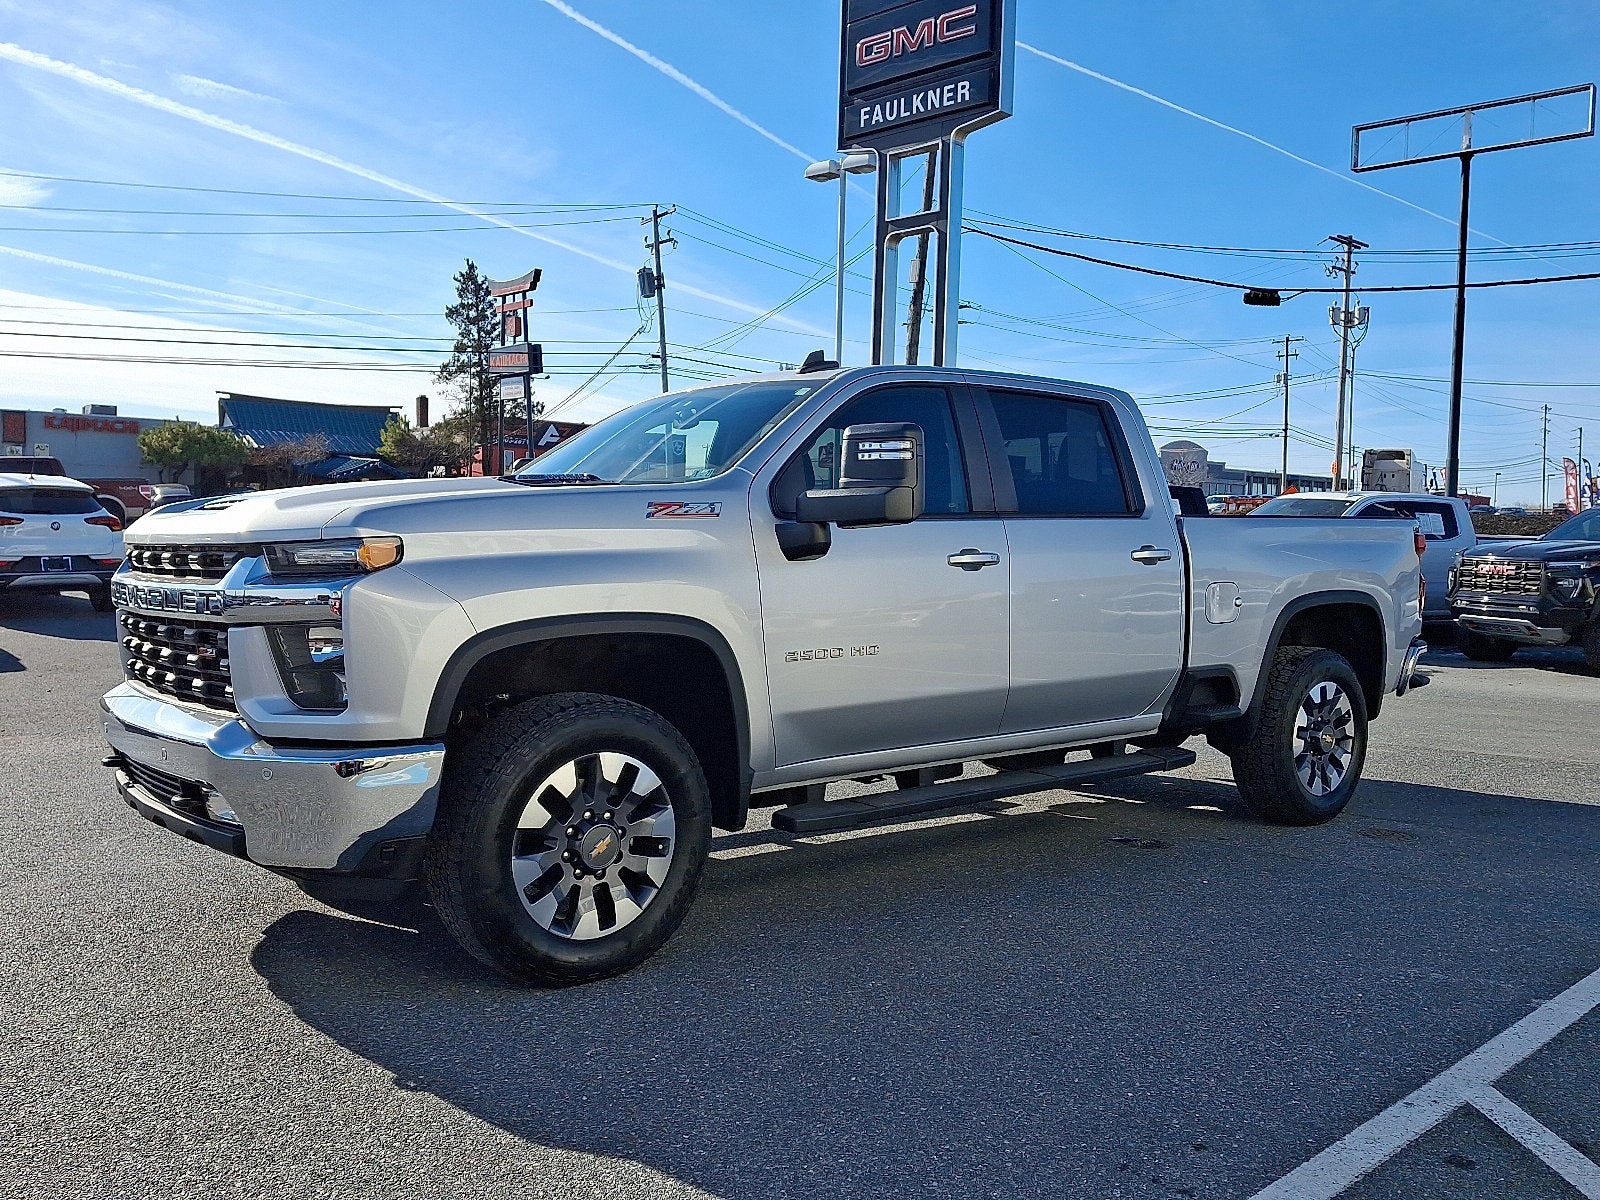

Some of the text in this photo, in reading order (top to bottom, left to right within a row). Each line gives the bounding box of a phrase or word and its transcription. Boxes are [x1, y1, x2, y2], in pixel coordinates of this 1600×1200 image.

[856, 4, 977, 67] GMC
[859, 80, 971, 128] FAULKNER
[646, 501, 722, 519] Z71
[1475, 564, 1516, 576] GMC
[784, 644, 880, 663] 2500 HD
